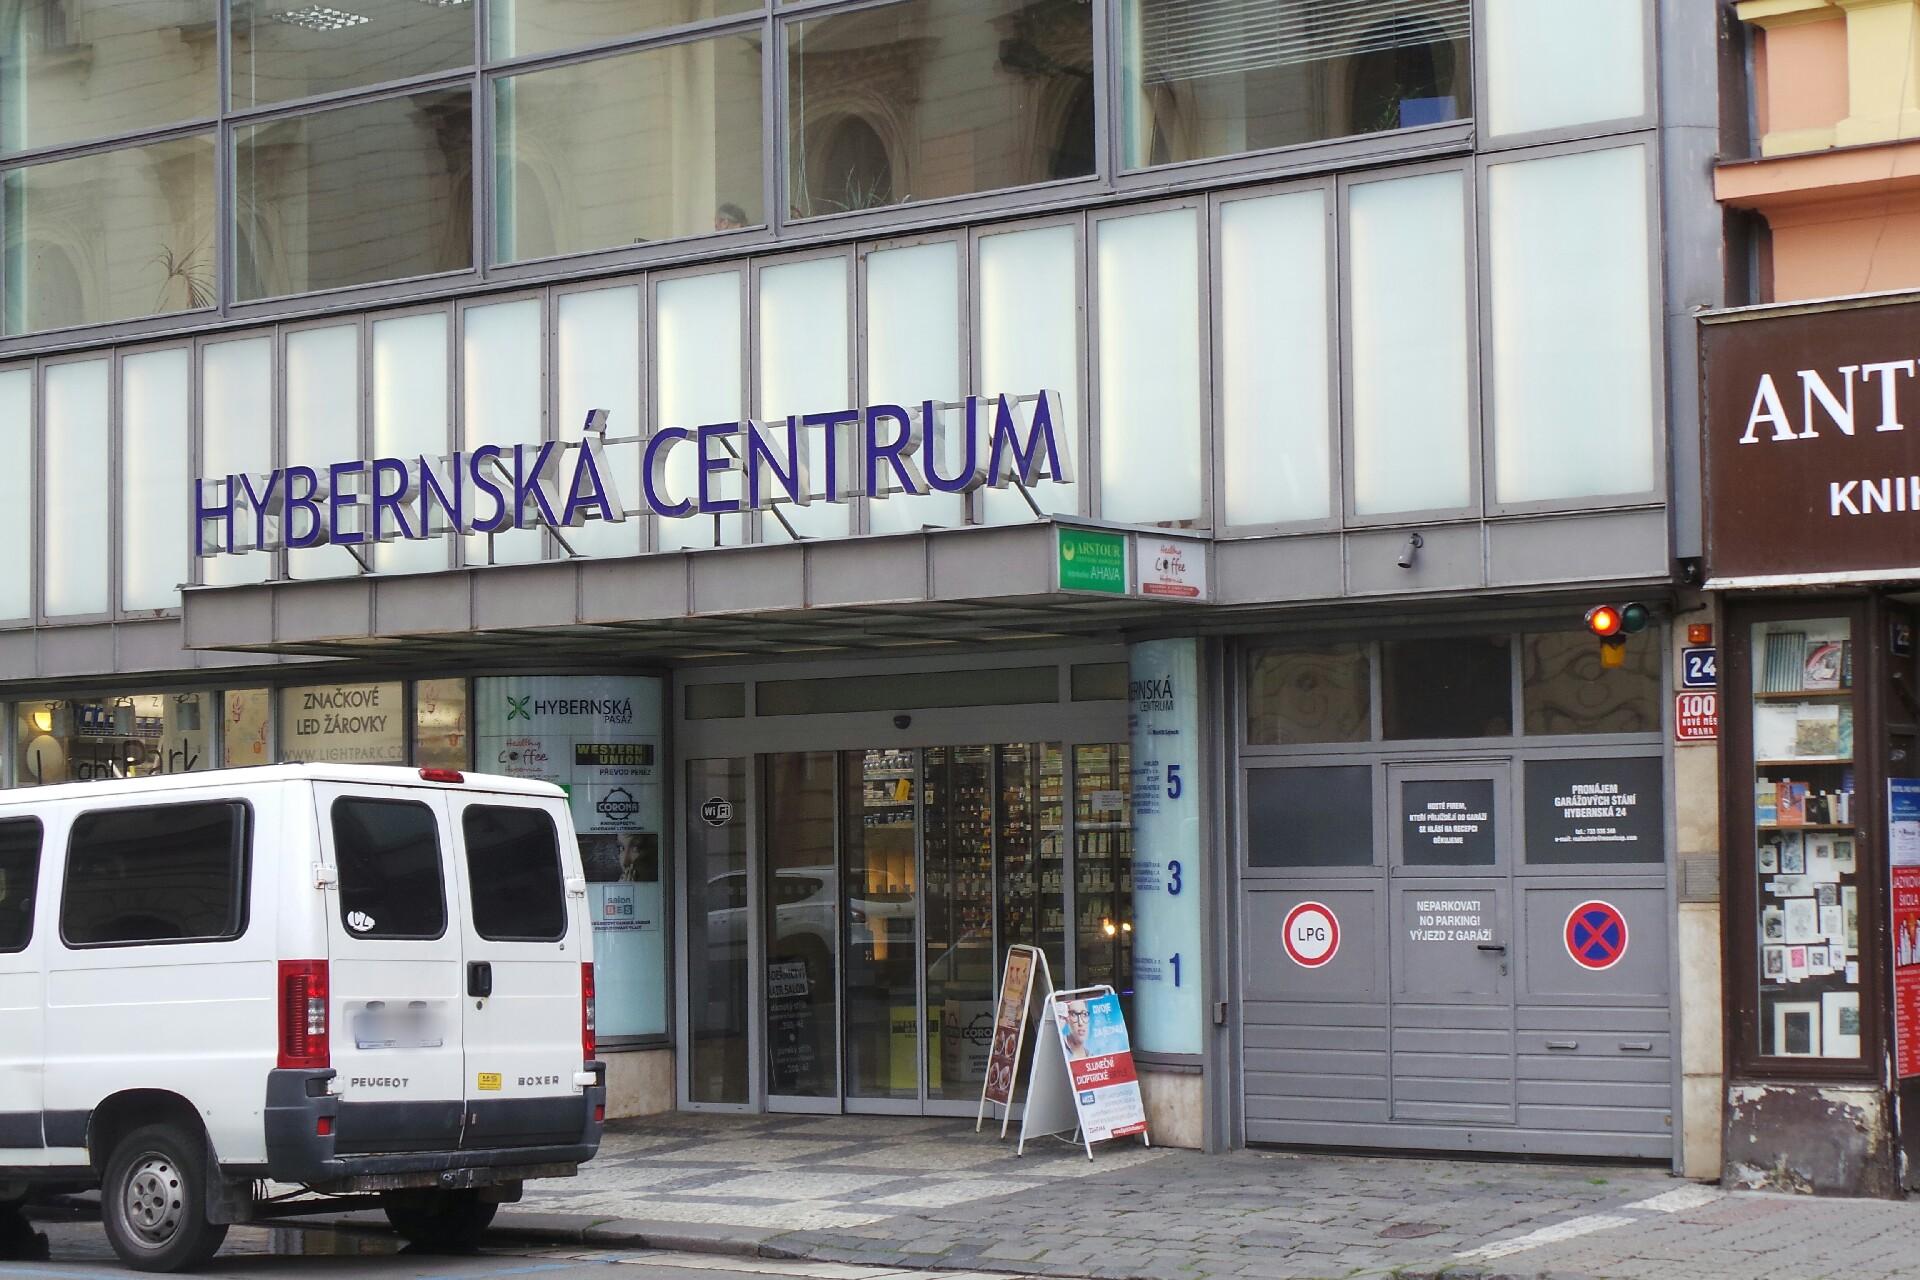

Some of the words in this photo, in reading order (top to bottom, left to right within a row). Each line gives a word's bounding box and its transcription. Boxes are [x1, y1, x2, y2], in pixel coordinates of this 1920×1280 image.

[1739, 358, 1920, 444] ANT
[195, 408, 617, 557] HYBERNSKÁ
[643, 390, 1066, 517] CENTRUM
[1078, 543, 1121, 557] ARSTOUR
[1090, 566, 1120, 581] AHAVA
[1690, 656, 1717, 677] 24
[304, 686, 380, 710] ZNAČKOVÉ
[534, 697, 633, 715] HYBERNSKÁ
[1139, 700, 1174, 712] CENTRUM
[296, 719, 320, 735] LED
[324, 714, 387, 734] ŽÁROVKY
[1682, 717, 1701, 726] NOVÉ
[1688, 727, 1713, 735] PRAHA
[577, 744, 643, 755] WESTERN
[600, 755, 643, 764] UNION
[1167, 764, 1182, 799] 5
[1571, 782, 1618, 794] PRONÁJEM
[1554, 794, 1610, 807] GARÁŽOVÝCH
[1611, 793, 1636, 805] STÁNÍ
[1564, 805, 1615, 818] HYBERNSKÁ
[1615, 807, 1627, 817] 24
[1167, 860, 1182, 895] 3
[1417, 900, 1480, 912] NEPARKOVAT!
[1420, 915, 1434, 926] NO
[1436, 915, 1480, 926] PARKING!
[1298, 927, 1325, 941] LPG
[1409, 928, 1446, 941] VÝJEZD
[1447, 930, 1455, 941] Z
[1455, 928, 1492, 941] GARÁŽÍ
[1169, 953, 1180, 987] 1
[963, 1028, 993, 1038] CORO
[351, 1077, 409, 1088] PEUGEOT
[518, 1075, 559, 1086] BOXER
